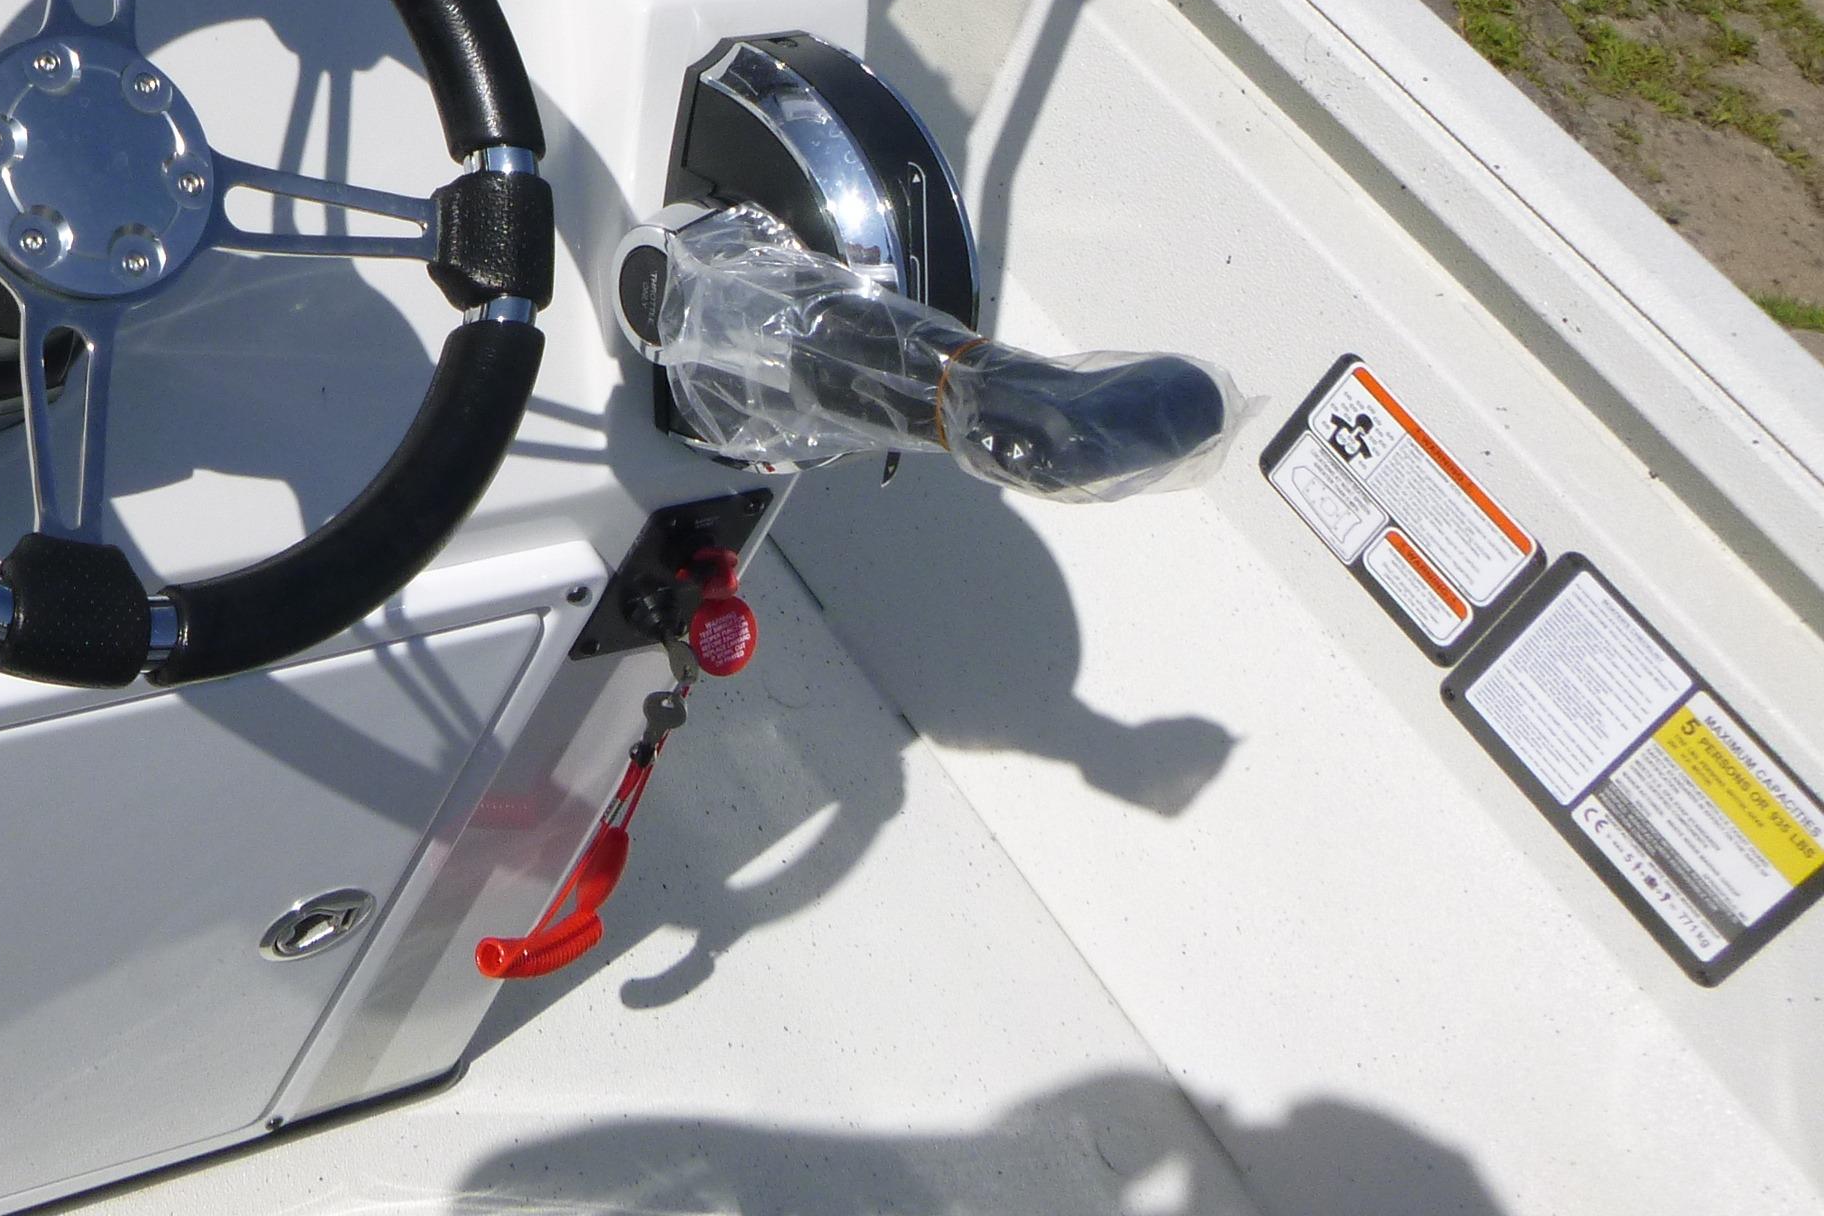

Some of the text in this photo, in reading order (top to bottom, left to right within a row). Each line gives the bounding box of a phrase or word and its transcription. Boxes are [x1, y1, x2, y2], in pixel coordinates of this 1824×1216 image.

[1679, 716, 1701, 738] 5
[1697, 736, 1751, 792] PERSONS
[1749, 789, 1769, 810] OR
[1789, 832, 1816, 860] LBS
[1704, 715, 1756, 770] MAXIMUM
[1754, 768, 1823, 838] CAPACITIES
